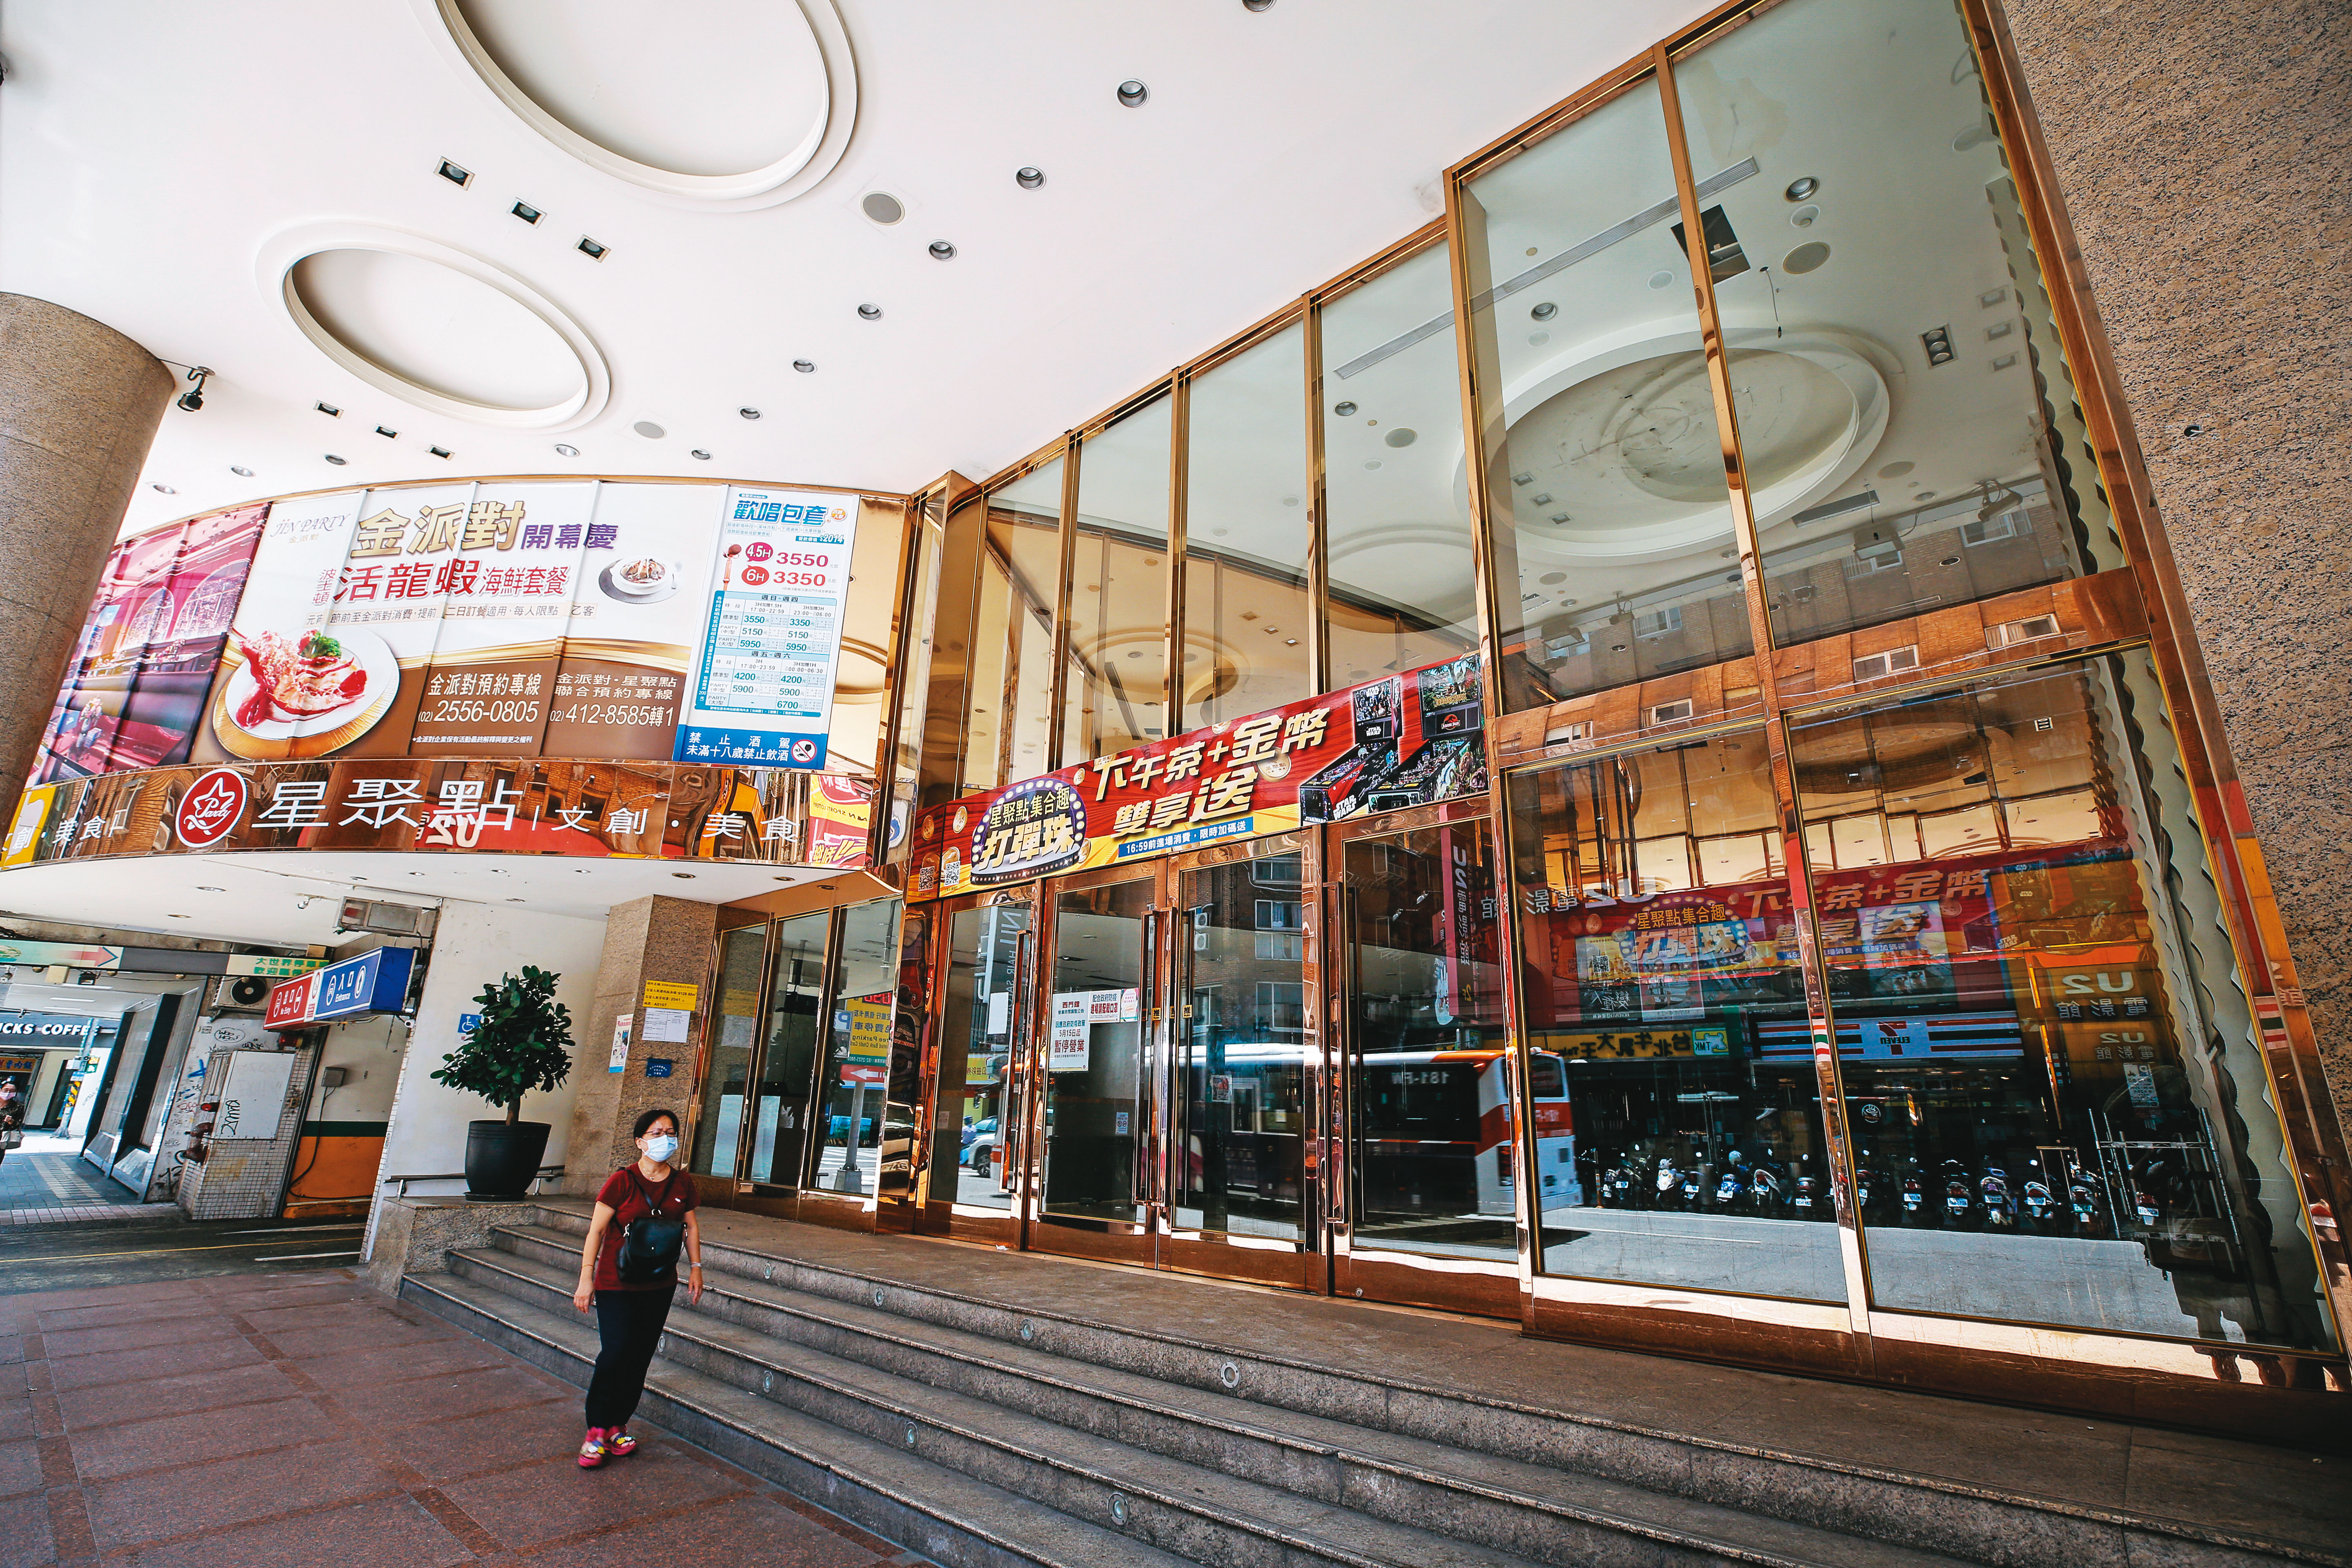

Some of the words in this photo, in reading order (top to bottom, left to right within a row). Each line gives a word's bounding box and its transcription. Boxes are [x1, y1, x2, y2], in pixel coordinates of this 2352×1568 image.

[733, 500, 827, 525] 歡唱包套
[301, 513, 352, 533] PARTY
[350, 501, 525, 558] 金派對
[520, 523, 619, 550] 開幕慶
[819, 534, 844, 543] $2014
[747, 545, 771, 557] 4.5H
[776, 552, 828, 567] 3550
[332, 558, 481, 603] 活龍蝦
[478, 565, 569, 596] 海鮮套餐
[746, 569, 764, 581] 6H
[773, 572, 825, 586] 3350
[427, 673, 543, 697] 金派對預約專線
[554, 685, 673, 701] 聯合預約專線
[1453, 693, 1467, 702] PARK
[686, 744, 790, 762] 未滿十八歲禁止飲酒
[251, 778, 524, 831] 星聚點
[989, 786, 1070, 829] 星聚點集合趣
[1110, 766, 1258, 838] 雙享送
[1333, 795, 1356, 813] STAR
[1333, 801, 1356, 820] WARS
[979, 814, 1076, 871] 打彈珠
[335, 992, 351, 1002] Entrance
[1093, 993, 1117, 1002] 配合政府防疫
[1091, 1003, 1118, 1014] 進場請配戴口罩
[1059, 1029, 1080, 1037] 5月15日起
[1055, 1039, 1085, 1053] 暫停營業
